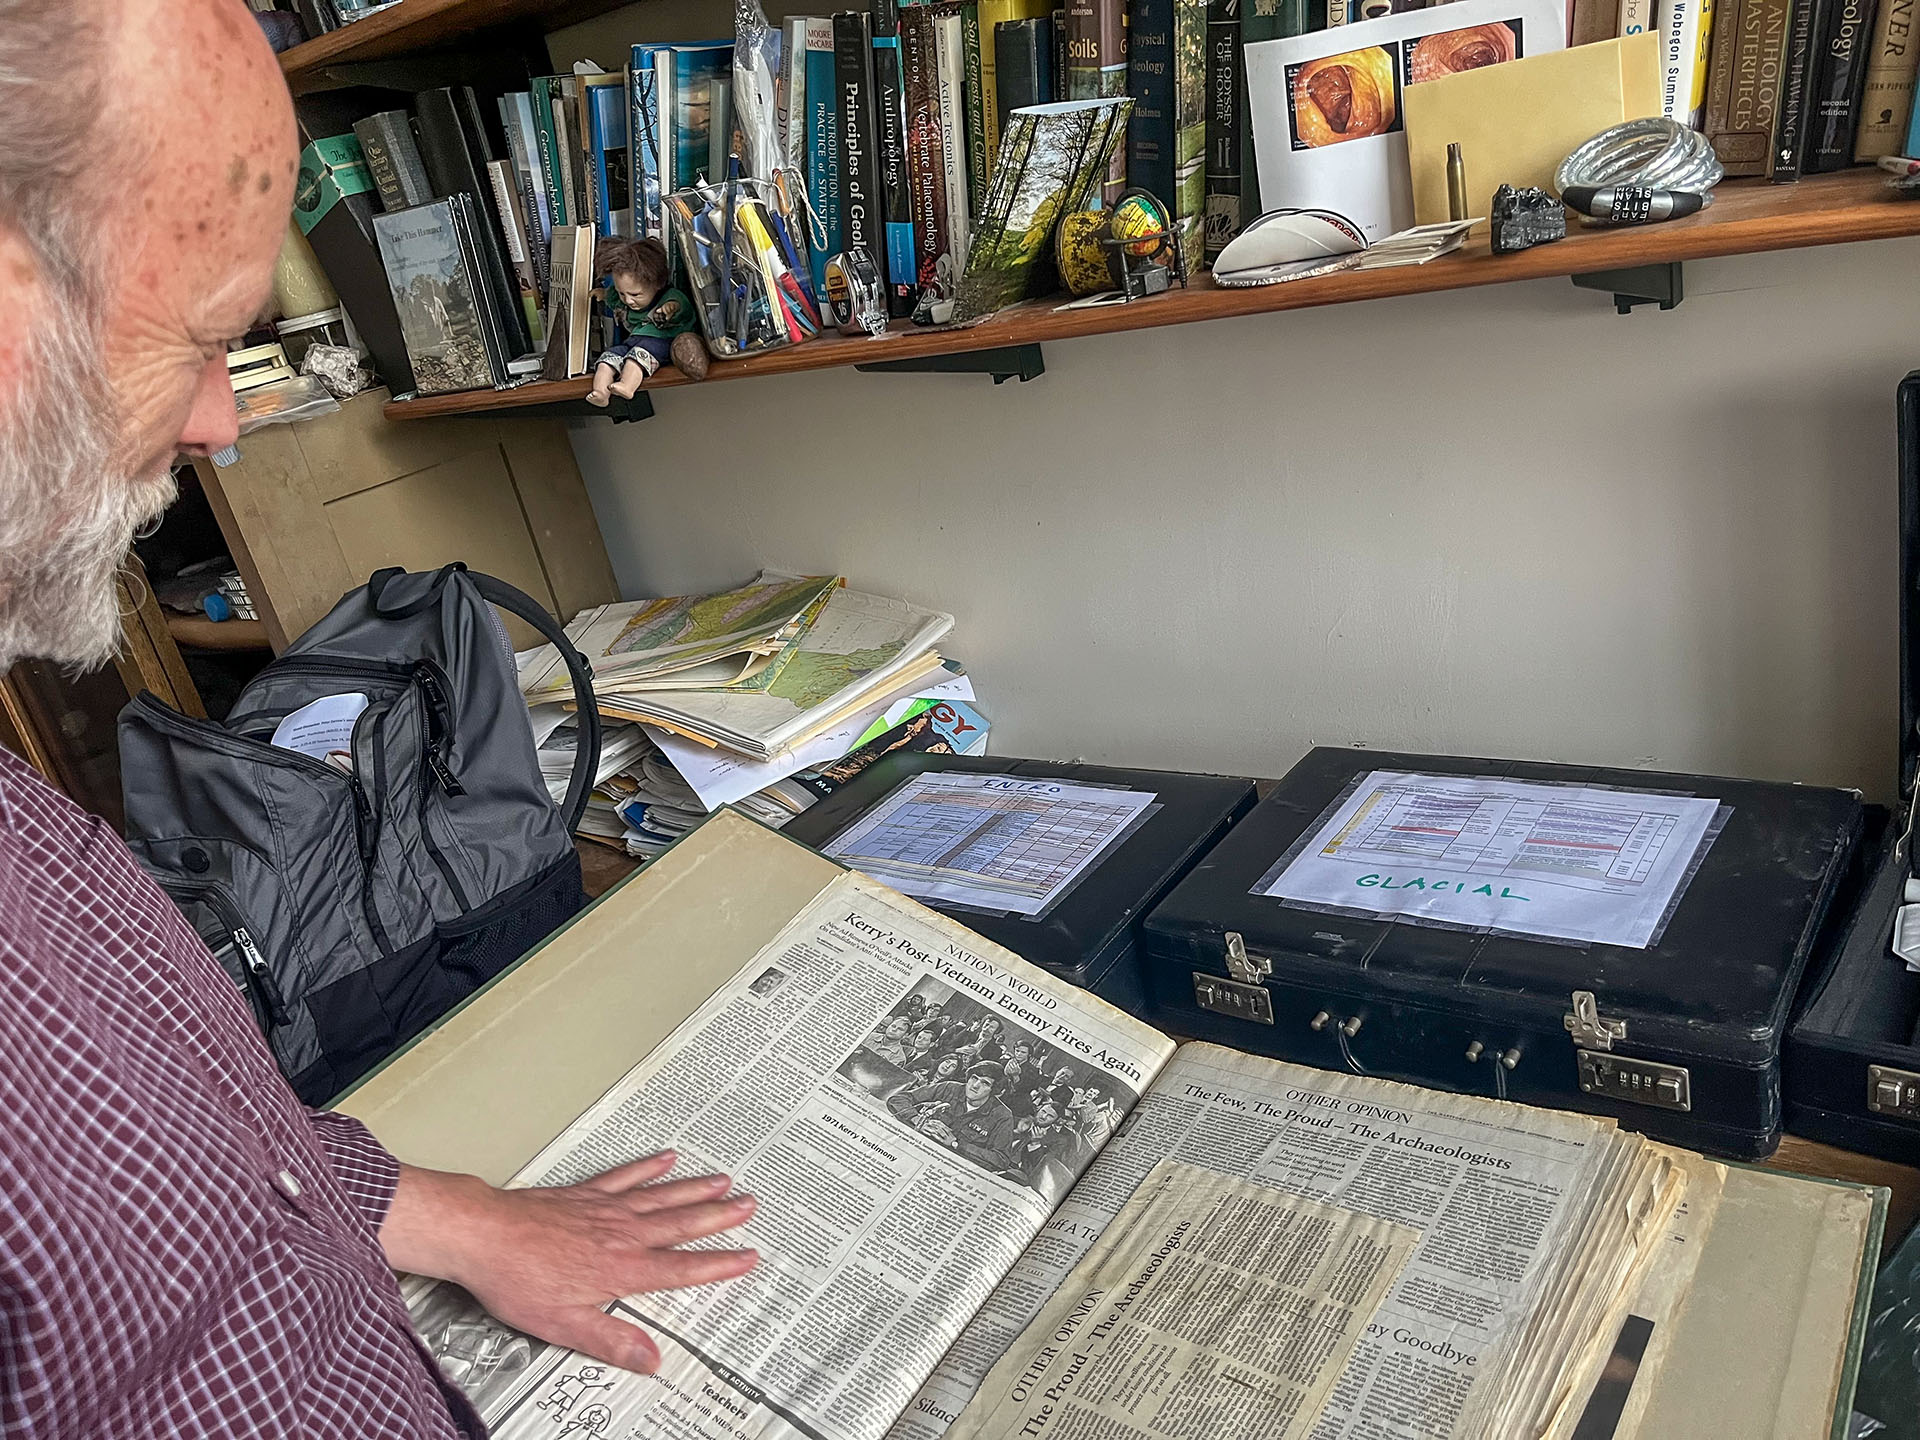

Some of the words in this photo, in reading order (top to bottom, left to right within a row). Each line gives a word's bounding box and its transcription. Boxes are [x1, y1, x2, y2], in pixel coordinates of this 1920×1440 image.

[807, 39, 833, 49] McCABE
[808, 29, 831, 39] MOORE
[967, 19, 978, 46] Soil
[1069, 38, 1098, 58] Soils
[1216, 42, 1224, 62] OF
[1223, 34, 1232, 62] THE
[1669, 3, 1686, 61] Wobegon
[909, 28, 920, 83] BENTON
[1131, 62, 1166, 74] Geology
[1756, 5, 1783, 130] ANTHOLOGY
[940, 80, 950, 118] Active
[969, 53, 980, 106] Genesis
[1216, 68, 1224, 120] HOMER
[1223, 67, 1232, 129] ODYSSEY
[1664, 67, 1680, 119] Summer
[1783, 64, 1803, 137] HAWKING
[973, 110, 981, 137] and
[1135, 107, 1161, 118] Holmes
[1822, 99, 1850, 107] second
[817, 103, 826, 157] PRACTICE
[846, 82, 863, 176] Principles
[883, 84, 900, 189] Anthropology
[918, 105, 932, 168] Vertebrate
[942, 122, 955, 175] Tectonics
[819, 162, 825, 170] of
[827, 112, 838, 198] INTRODUCTION
[494, 180, 509, 206] College
[541, 130, 561, 227] Geomorphology
[849, 180, 865, 200] of
[830, 204, 838, 213] to
[830, 215, 838, 231] the
[922, 173, 938, 255] Palaeontology
[1613, 201, 1650, 211] BITS
[405, 230, 417, 240] This
[418, 225, 443, 238] Hammer
[525, 176, 544, 246] Environmental
[540, 246, 550, 282] Geology
[930, 703, 978, 736] GY
[815, 780, 832, 794] MA
[983, 778, 1061, 794] INTRO
[1356, 874, 1532, 902] GLACIAL
[818, 924, 829, 933] On
[828, 929, 860, 949] Candidate's
[858, 946, 886, 962] Anti-War
[884, 960, 911, 977] Activities
[825, 921, 840, 931] New
[847, 932, 869, 947] Renews
[891, 956, 913, 970] Attacks
[843, 912, 896, 945] Kerry's
[896, 939, 995, 1000] Post-Vietnam
[995, 993, 1053, 1032] Enemy
[1051, 1024, 1092, 1054] Fires
[1092, 1049, 1141, 1082] Again
[944, 943, 998, 976] NATION
[1008, 976, 1057, 1010] WORLD
[1184, 1083, 1211, 1100] The
[1212, 1092, 1246, 1111] Few,
[1253, 1100, 1282, 1118] The
[1282, 1109, 1334, 1129] Proud
[1349, 1122, 1381, 1139] The
[1382, 1129, 1513, 1171] Archaeologists
[1286, 1089, 1341, 1112] OTHER
[1346, 1102, 1413, 1124] OPINION
[821, 1114, 840, 1127] 1971
[838, 1123, 860, 1139] Kerry
[859, 1135, 898, 1162] Testimony
[1064, 1223, 1078, 1235] A
[1011, 1346, 1058, 1402] OTHER
[1054, 1287, 1106, 1342] OPINION
[1018, 1404, 1053, 1438] The
[1045, 1353, 1088, 1403] Proud
[1087, 1314, 1120, 1340] The
[1114, 1220, 1192, 1312] Archaeologists
[1367, 1322, 1390, 1339] ay
[1393, 1328, 1478, 1366] Goodbye
[718, 1367, 730, 1378] NIE
[730, 1376, 761, 1399] ACTIVITY
[1110, 1387, 1126, 1402] They
[1123, 1378, 1131, 1389] are
[1129, 1360, 1146, 1379] willing
[1146, 1343, 1159, 1356] work
[1120, 1390, 1134, 1408] under
[1130, 1375, 1145, 1391] lousy
[1142, 1350, 1164, 1377] conditions
[1127, 1393, 1144, 1415] protect
[1141, 1366, 1164, 1394] something
[1160, 1346, 1178, 1369] precious
[1150, 1385, 1160, 1397] for
[673, 1389, 694, 1404] year
[694, 1402, 712, 1418] with
[712, 1414, 734, 1433] NIE's
[701, 1381, 749, 1420] Teachers
